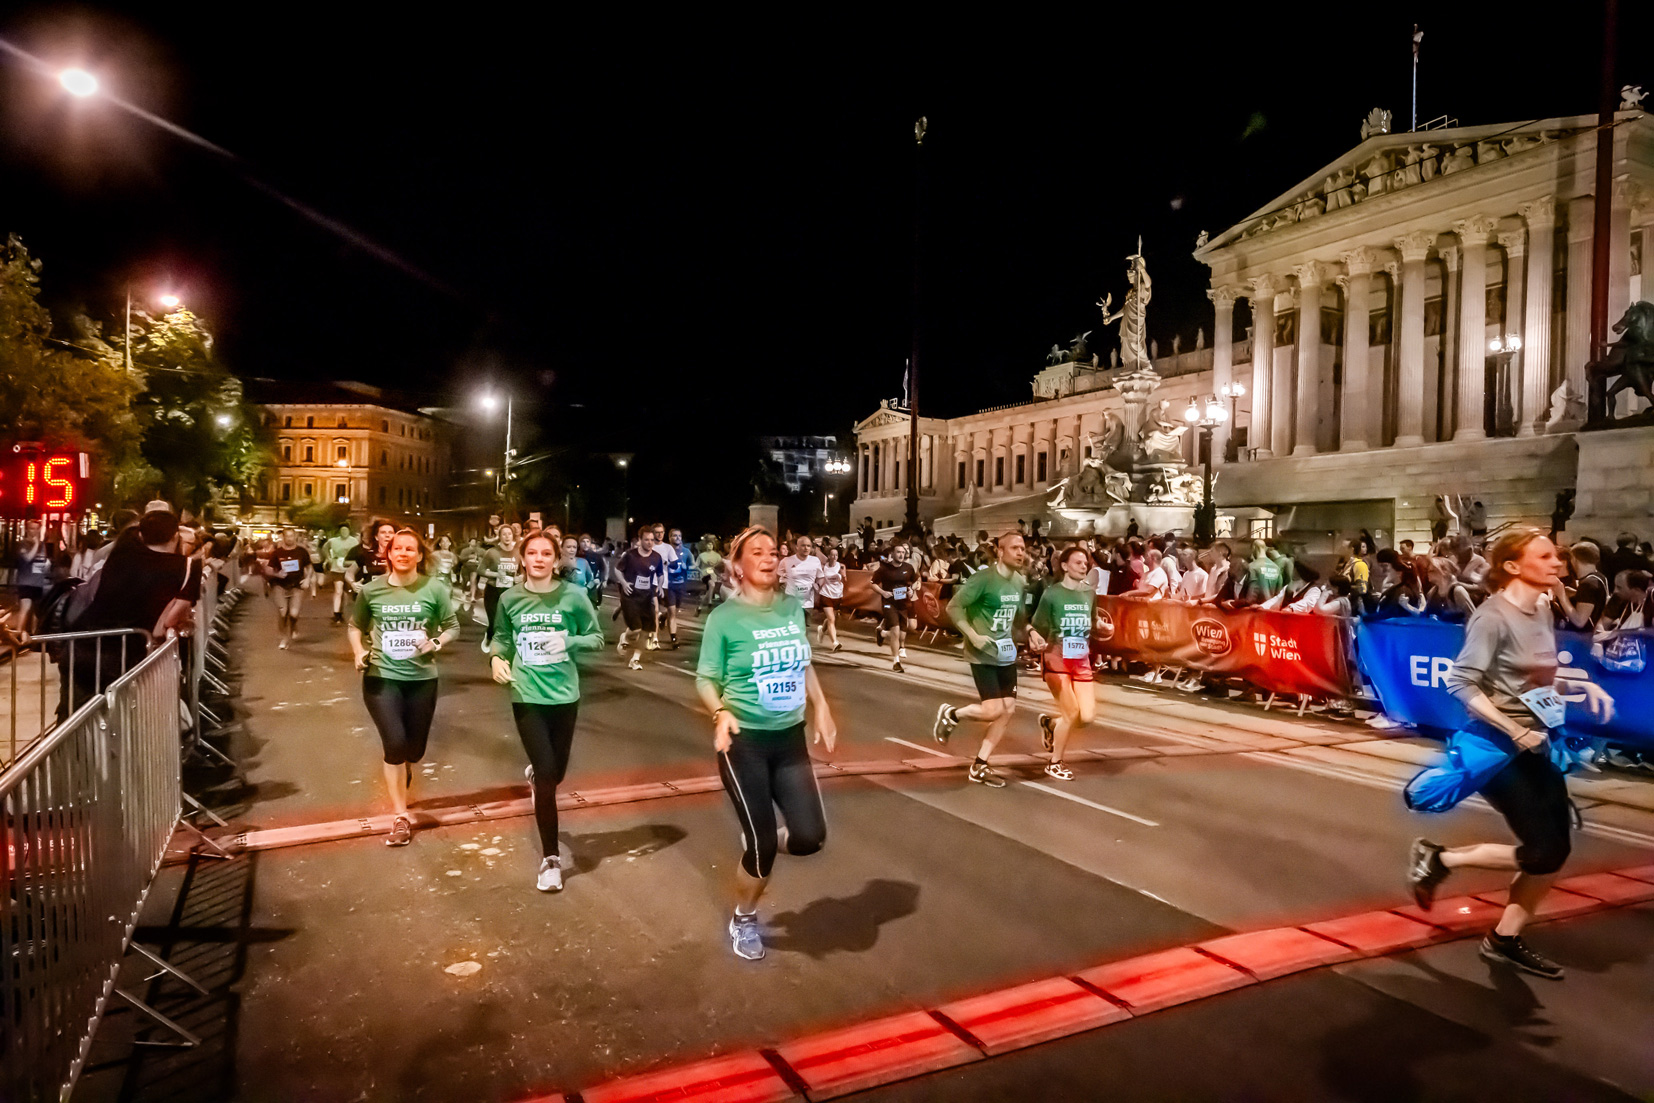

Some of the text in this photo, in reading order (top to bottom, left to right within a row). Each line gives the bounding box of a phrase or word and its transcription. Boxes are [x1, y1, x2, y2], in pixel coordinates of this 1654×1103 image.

[381, 605, 411, 613] ERSTE
[521, 613, 551, 623] ERSTE
[752, 626, 790, 640] ERSTE
[1196, 625, 1223, 639] Wien
[1068, 642, 1085, 650] 15772
[1270, 635, 1298, 650] Stadt
[1270, 647, 1302, 661] Wien
[766, 681, 797, 694] 12155
